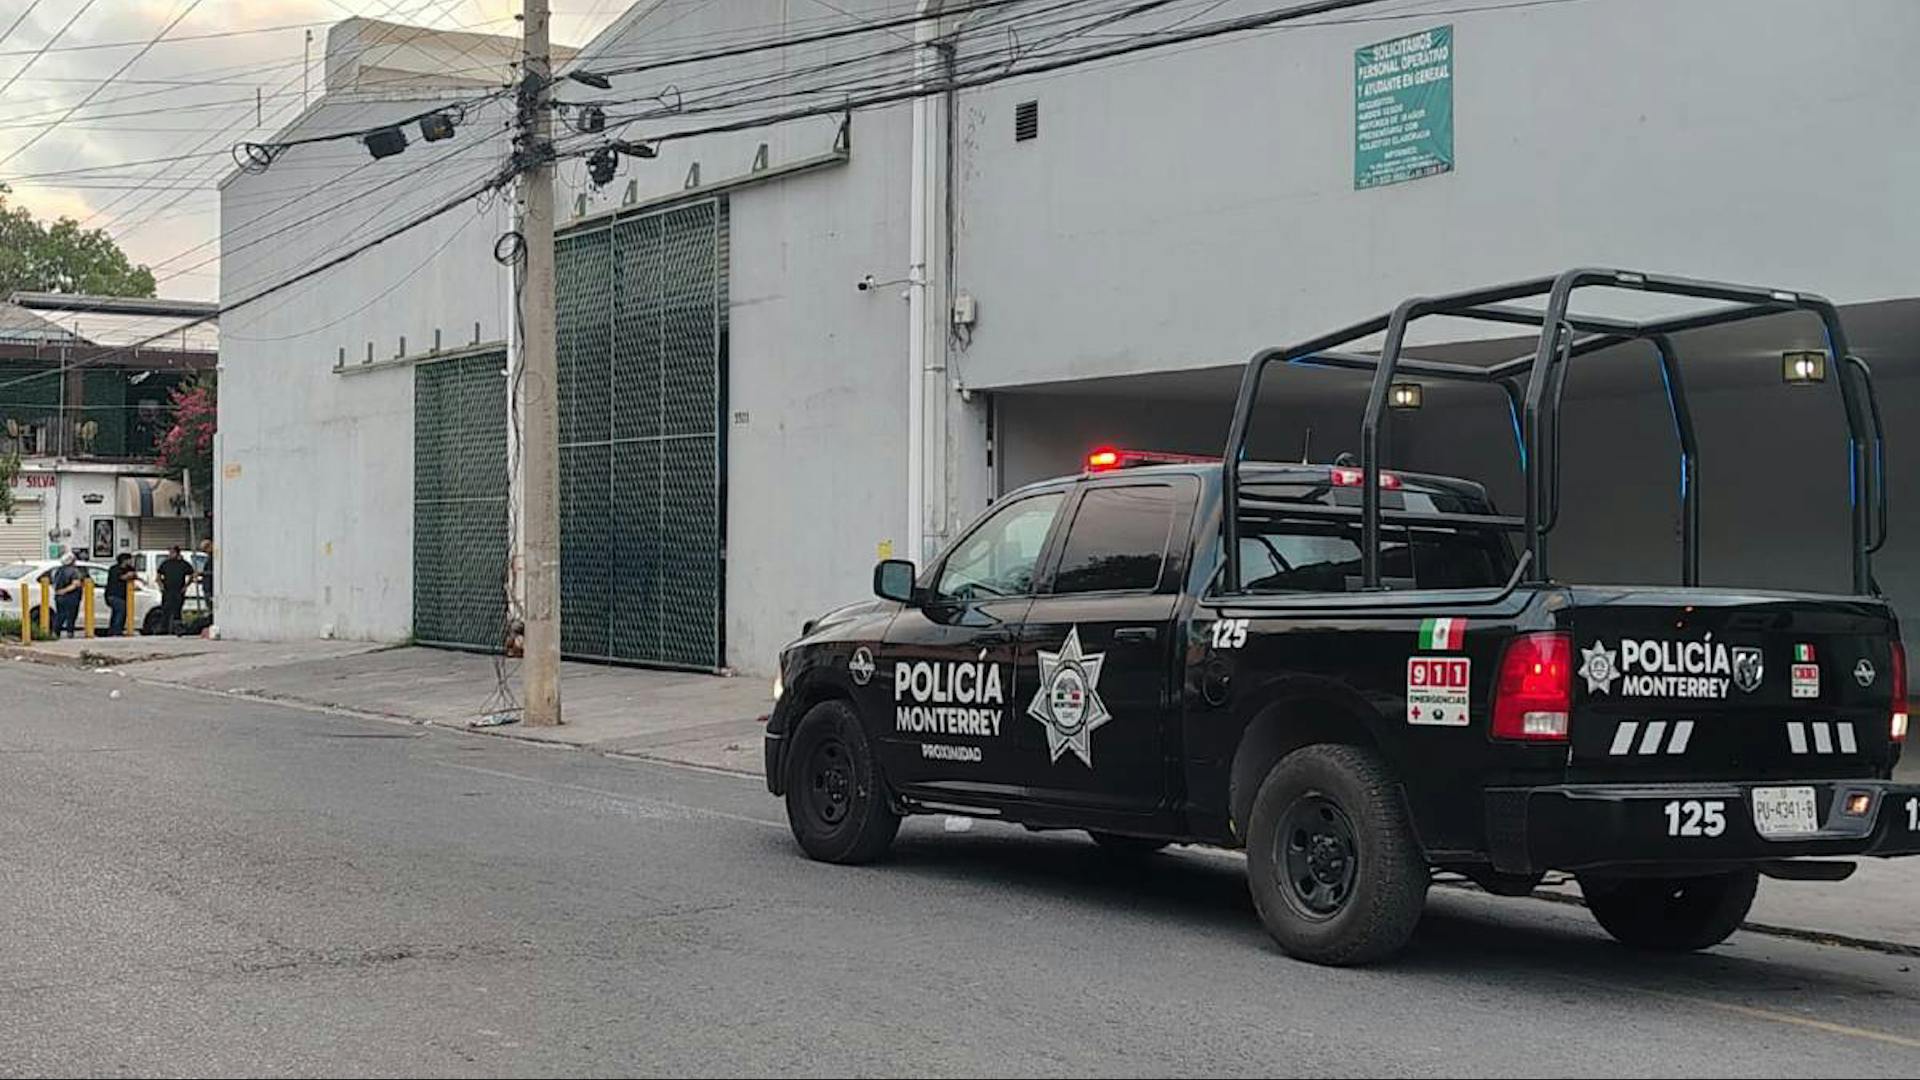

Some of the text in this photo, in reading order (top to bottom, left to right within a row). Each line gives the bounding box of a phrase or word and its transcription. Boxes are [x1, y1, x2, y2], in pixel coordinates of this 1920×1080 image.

[1358, 45, 1449, 80] PERSONAL OPERATIVO
[1373, 32, 1432, 62] SOLICITAMOS
[1364, 75, 1402, 97] AYUDANTE
[1415, 64, 1449, 85] GENERAL
[26, 475, 55, 488] SILVA
[1211, 618, 1250, 649] 125
[1621, 631, 1731, 675] POLICÍA
[895, 647, 1004, 705] POLICÍA
[1412, 663, 1463, 685] 911
[1621, 674, 1731, 699] MONTERREY
[1409, 695, 1467, 705] EMERGENCIAS
[896, 706, 1003, 737] MONTERREY
[921, 743, 982, 762] PROXIMIDAD
[1664, 800, 1726, 837] 125
[1905, 797, 1920, 831] 1
